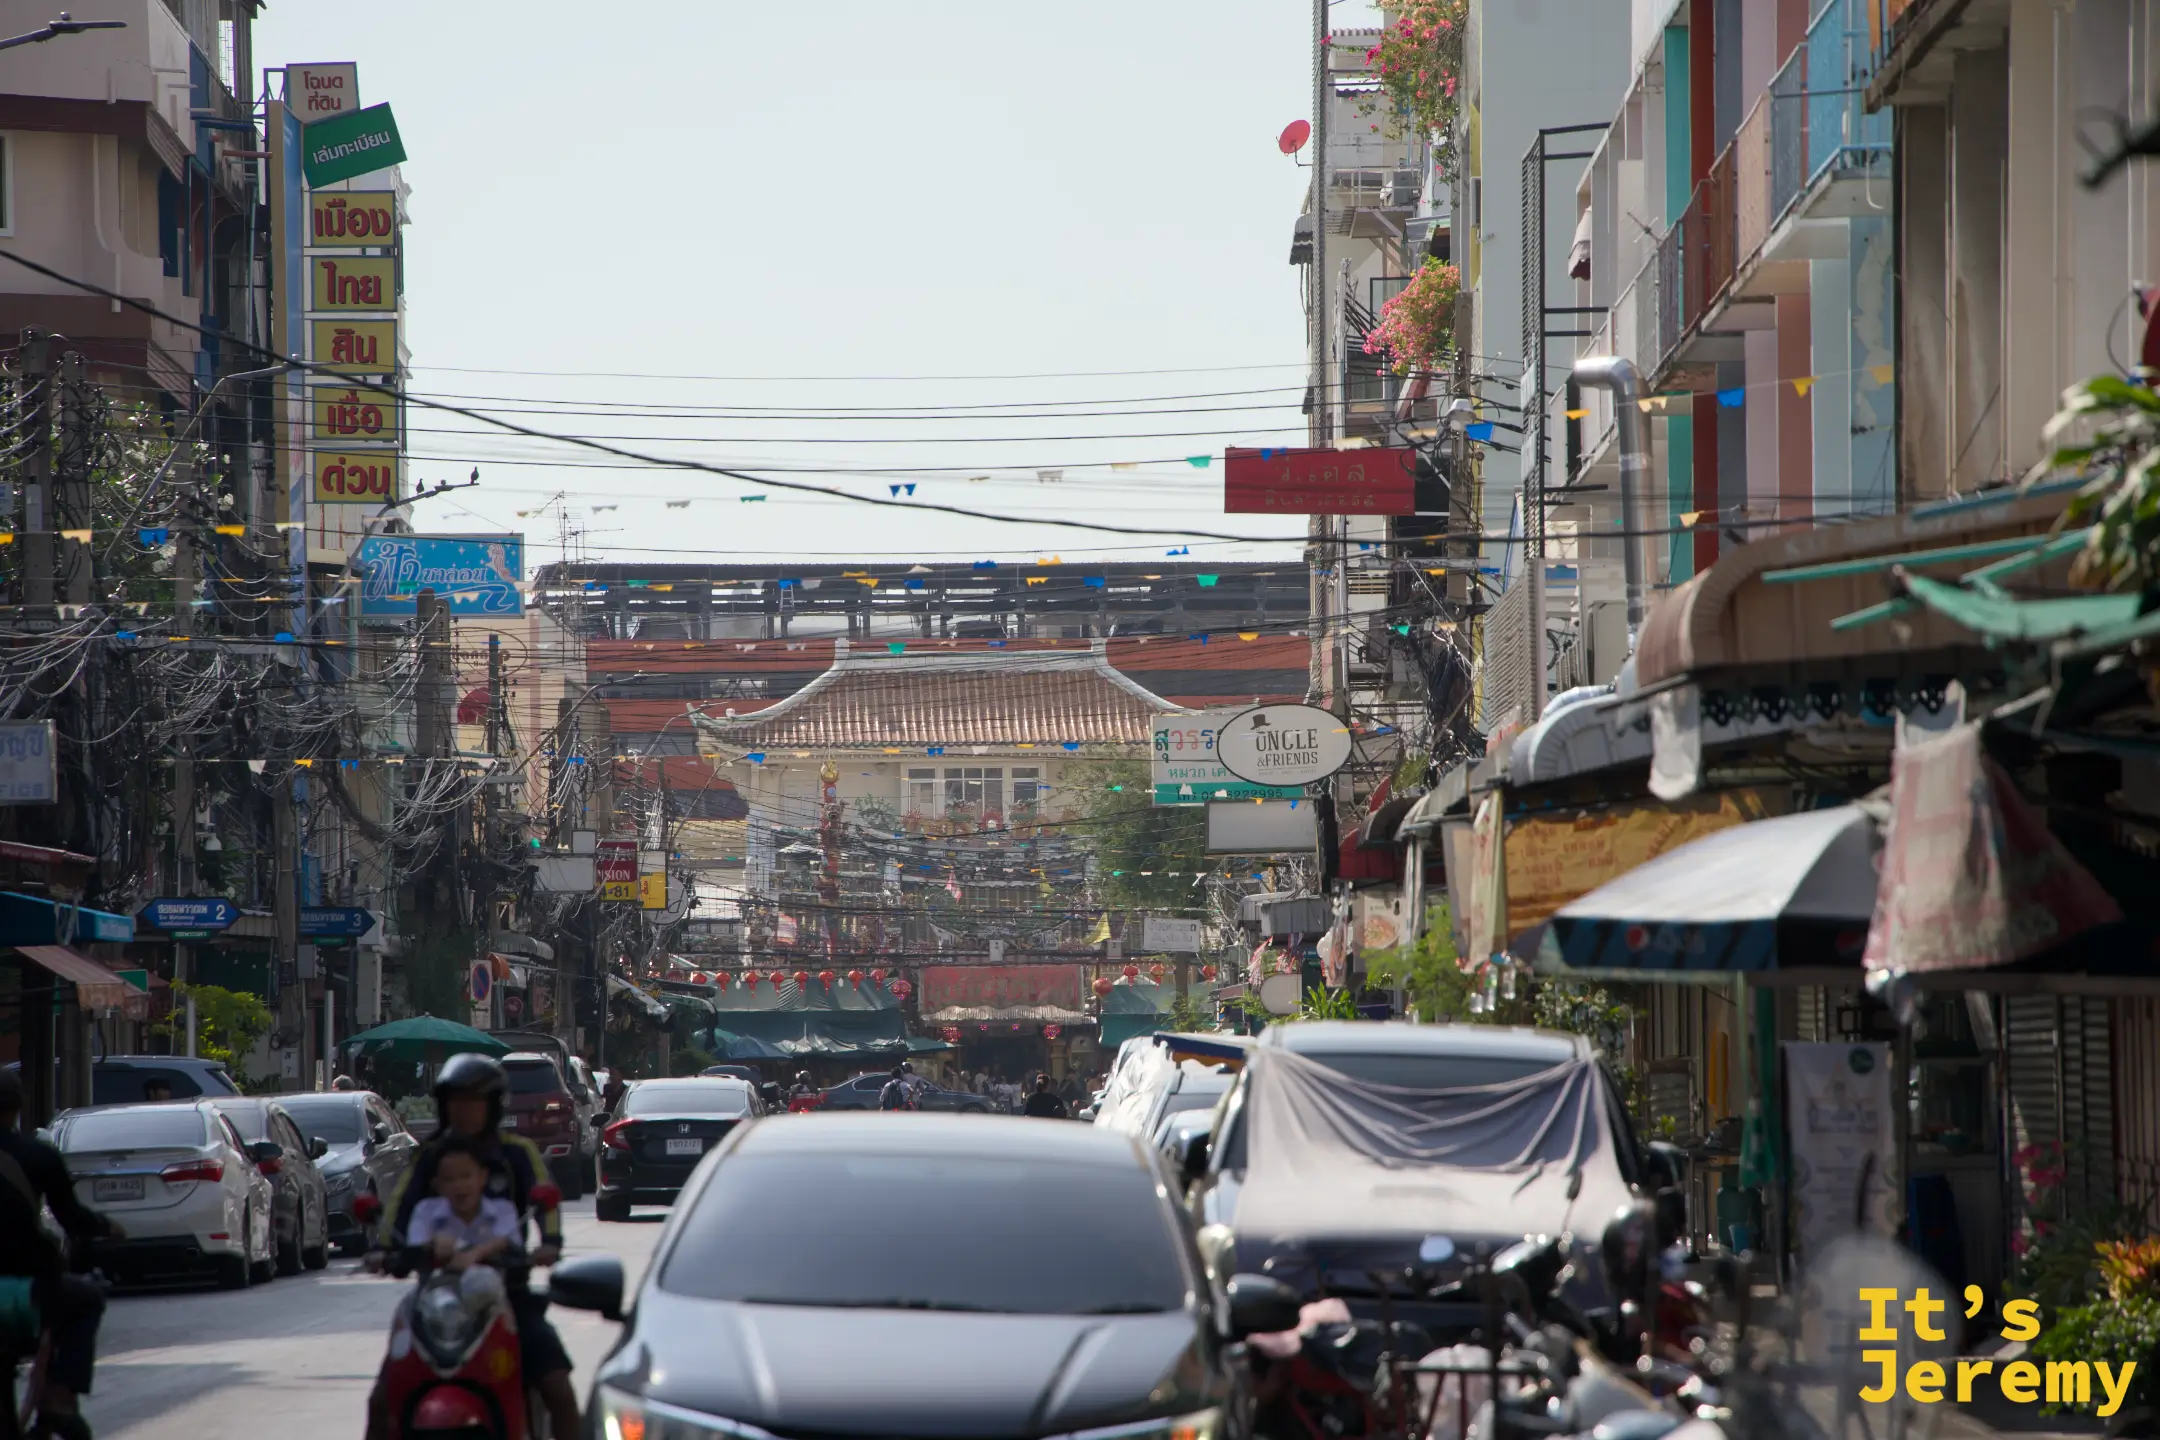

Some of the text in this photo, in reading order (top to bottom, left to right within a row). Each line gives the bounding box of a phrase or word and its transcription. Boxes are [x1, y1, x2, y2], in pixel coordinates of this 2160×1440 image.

[303, 71, 344, 90] โฉนด
[307, 91, 342, 111] ที่ดิน
[312, 130, 392, 165] เล่มทะเบียน
[314, 198, 392, 237] เมือง
[320, 261, 382, 304] ไทย
[332, 328, 377, 364] สิน
[327, 388, 383, 435] เชื่อ
[322, 456, 391, 495] ด่วน
[1155, 728, 1222, 764] สุวรร
[1256, 728, 1319, 752] UNCLE
[1257, 751, 1319, 767] &FRIENDS
[215, 904, 226, 920] 2
[353, 913, 362, 927] 3
